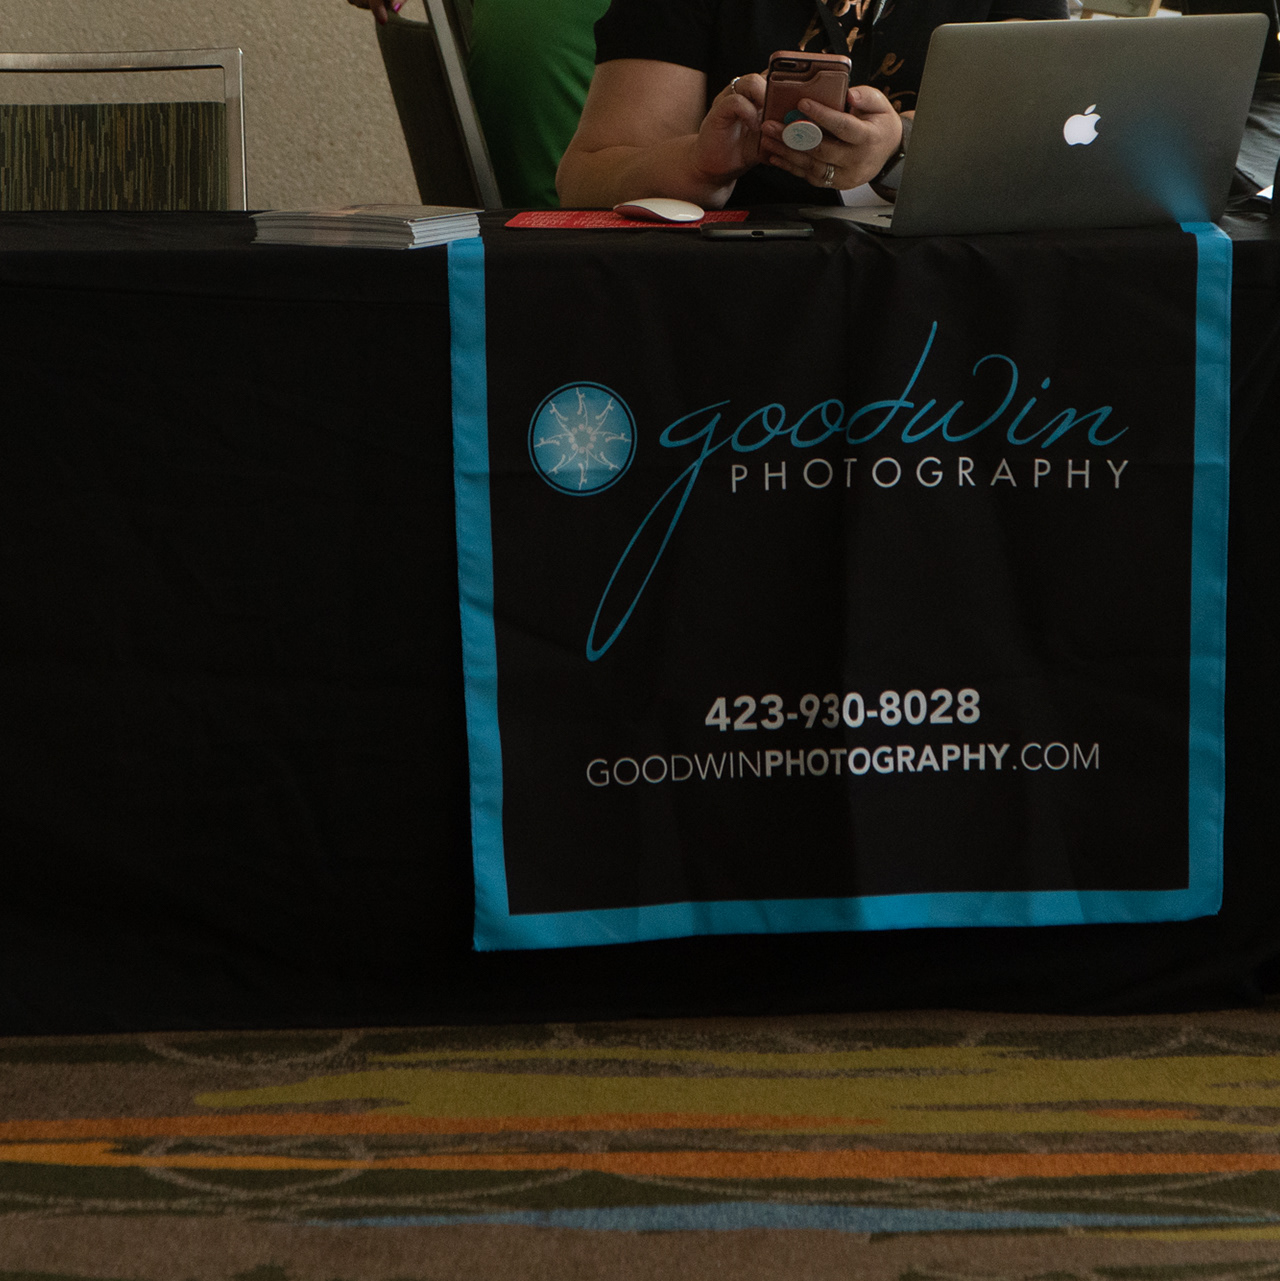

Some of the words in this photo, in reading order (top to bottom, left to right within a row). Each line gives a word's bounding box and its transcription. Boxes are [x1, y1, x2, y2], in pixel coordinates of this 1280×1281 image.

[586, 321, 1129, 662] goodwin
[730, 455, 1130, 493] PHOTOGRAPHY
[704, 687, 981, 732] 423-930-8028
[585, 741, 1102, 787] GOODWINPHOTOGRAPHY.COM
